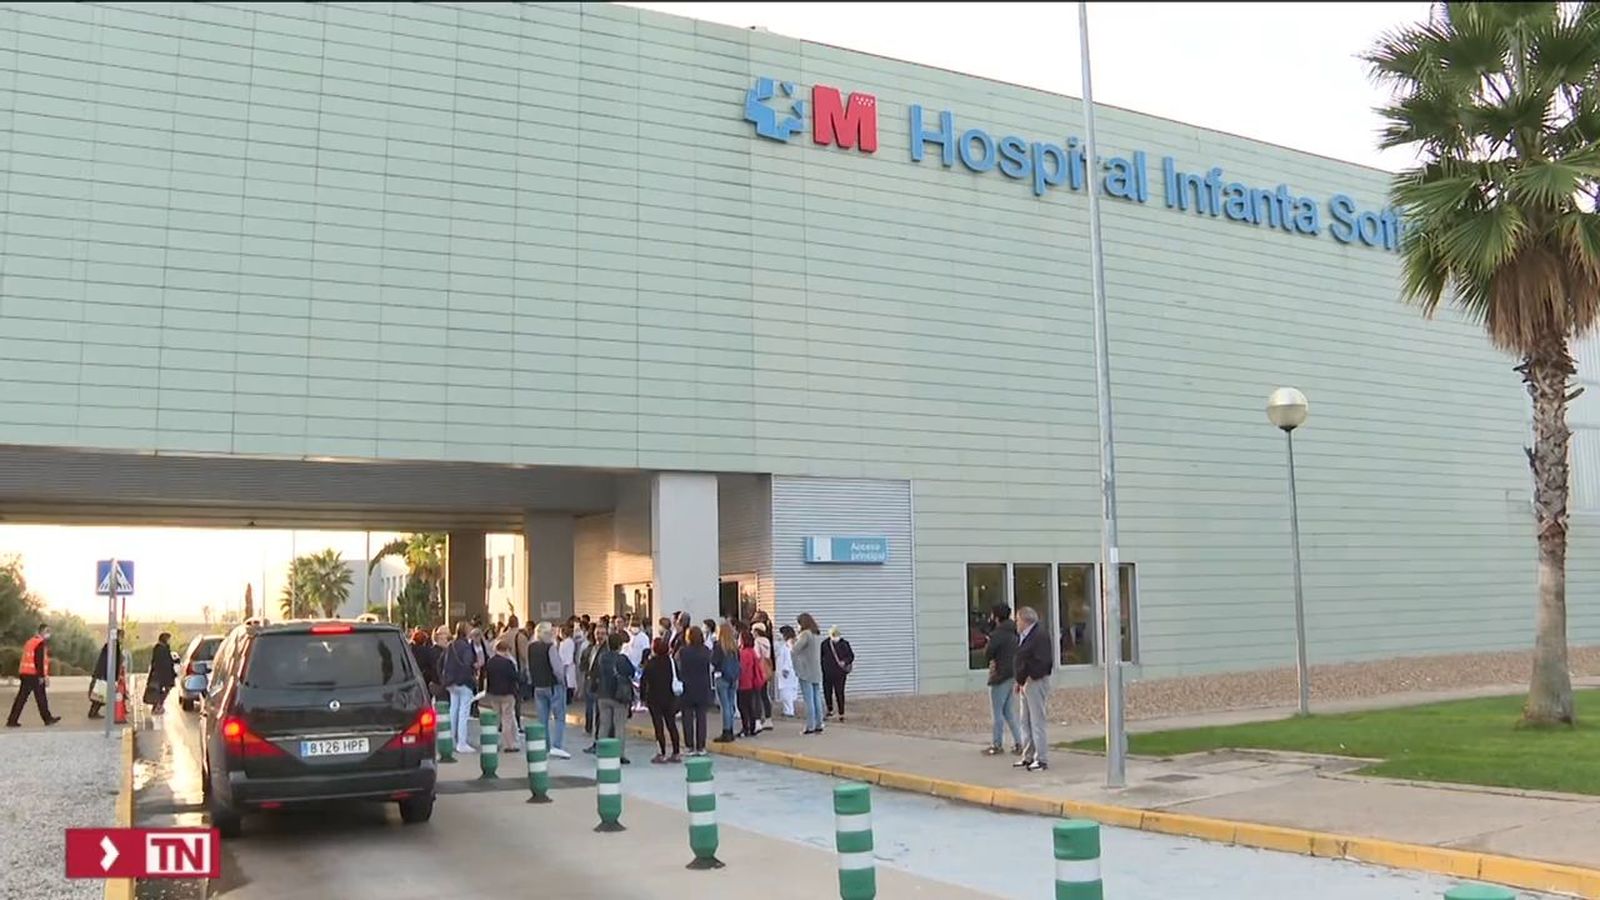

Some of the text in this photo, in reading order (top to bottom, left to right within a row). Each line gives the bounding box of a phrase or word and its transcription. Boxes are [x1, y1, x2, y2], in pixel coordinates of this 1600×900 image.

[812, 85, 1401, 251] M Hospial Infanta Sof
[310, 741, 340, 754] 8126
